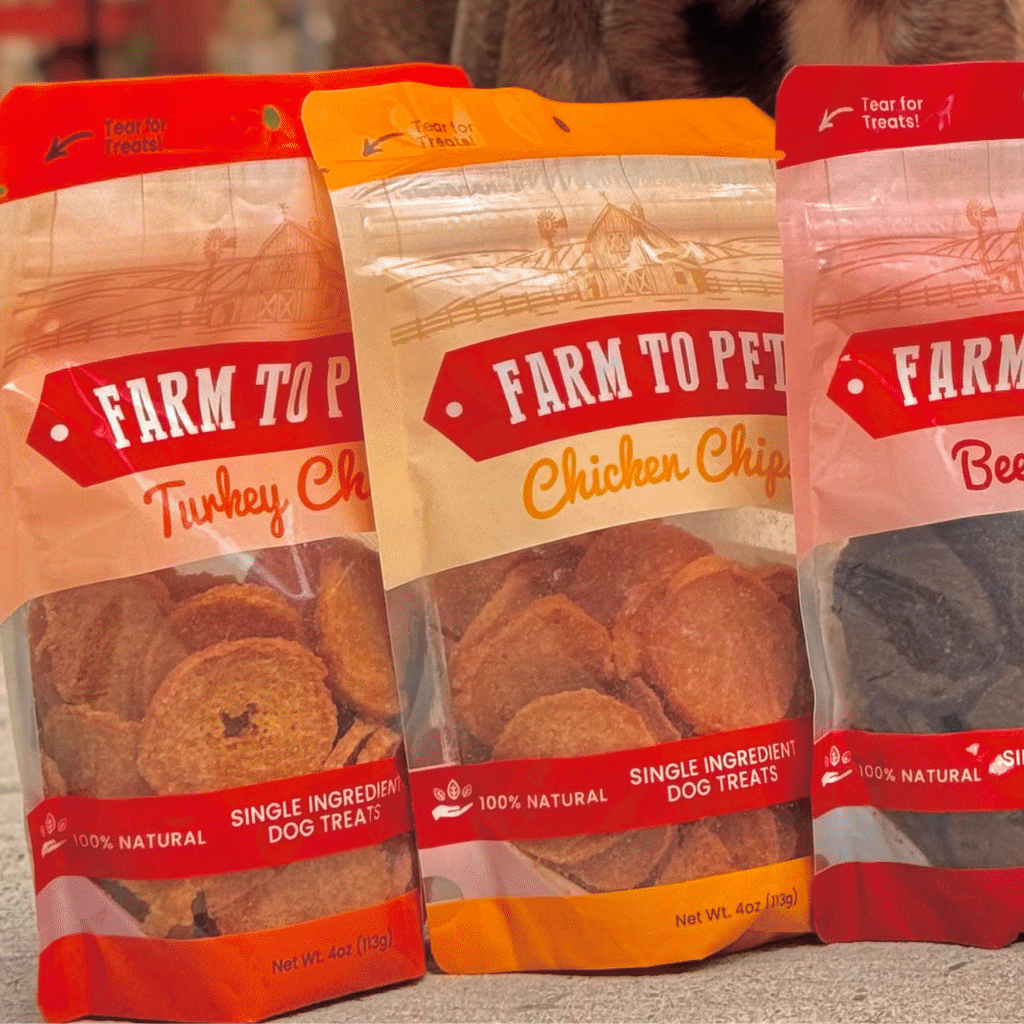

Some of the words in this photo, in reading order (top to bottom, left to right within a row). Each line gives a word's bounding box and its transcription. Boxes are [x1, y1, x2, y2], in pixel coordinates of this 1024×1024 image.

[861, 96, 897, 112] Tear
[899, 96, 923, 112] for
[105, 120, 141, 136] Tear
[146, 116, 167, 134] for
[411, 120, 447, 134] Tear
[862, 114, 921, 130] Treats!
[104, 136, 163, 155] Treats!
[493, 337, 632, 425] FARM
[638, 331, 700, 394] TO
[709, 330, 787, 391] PET
[94, 365, 235, 449] FARM
[255, 361, 313, 426] TO
[522, 434, 689, 520] Chicken
[144, 465, 289, 538] Turkey
[630, 759, 699, 786] SINGLE
[703, 739, 797, 774] INGREDIENT
[858, 764, 896, 782] 100%
[901, 766, 982, 783] NATURAL
[479, 793, 521, 811] 100%
[527, 788, 608, 810] NATURAL
[667, 779, 711, 803] DOG
[716, 765, 778, 792] TREATS
[230, 798, 302, 828] SINGLE
[268, 819, 314, 844] DOG
[320, 804, 381, 833] TREATS
[73, 833, 114, 851] 100%
[119, 830, 207, 850] NATURAL
[675, 912, 701, 928] Net
[705, 905, 731, 922] Wt.
[735, 899, 761, 915] 4oz
[765, 888, 798, 909] (113g)
[272, 956, 299, 974] Net
[301, 950, 325, 967] Wt.
[328, 943, 352, 959] 4oz
[356, 928, 393, 956] (113g)
